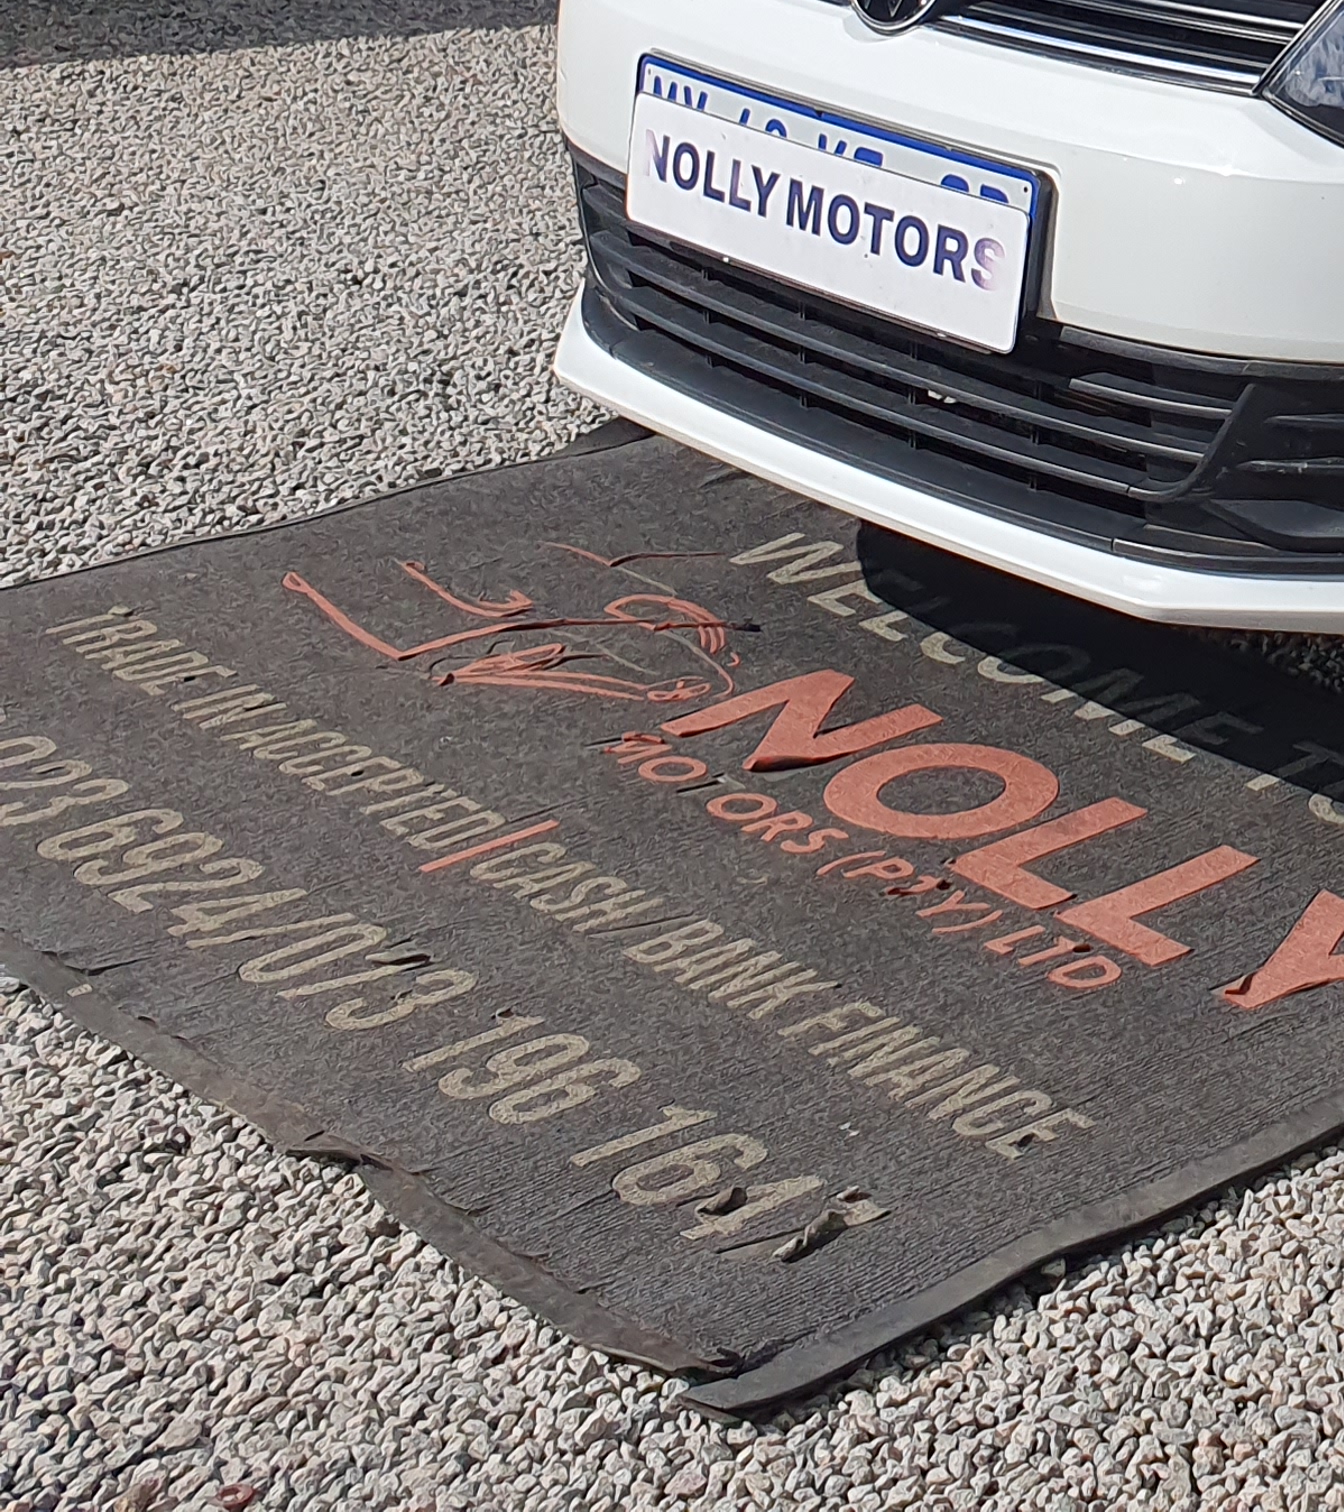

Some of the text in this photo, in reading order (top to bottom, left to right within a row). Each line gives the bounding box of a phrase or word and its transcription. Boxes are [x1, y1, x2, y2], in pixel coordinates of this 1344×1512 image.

[646, 129, 1006, 291] NOLLY MOTORS
[729, 532, 1264, 763] WELCOME
[984, 924, 1122, 988] LTD
[402, 1007, 642, 1125] 196
[777, 1000, 1096, 1160] FINANCE
